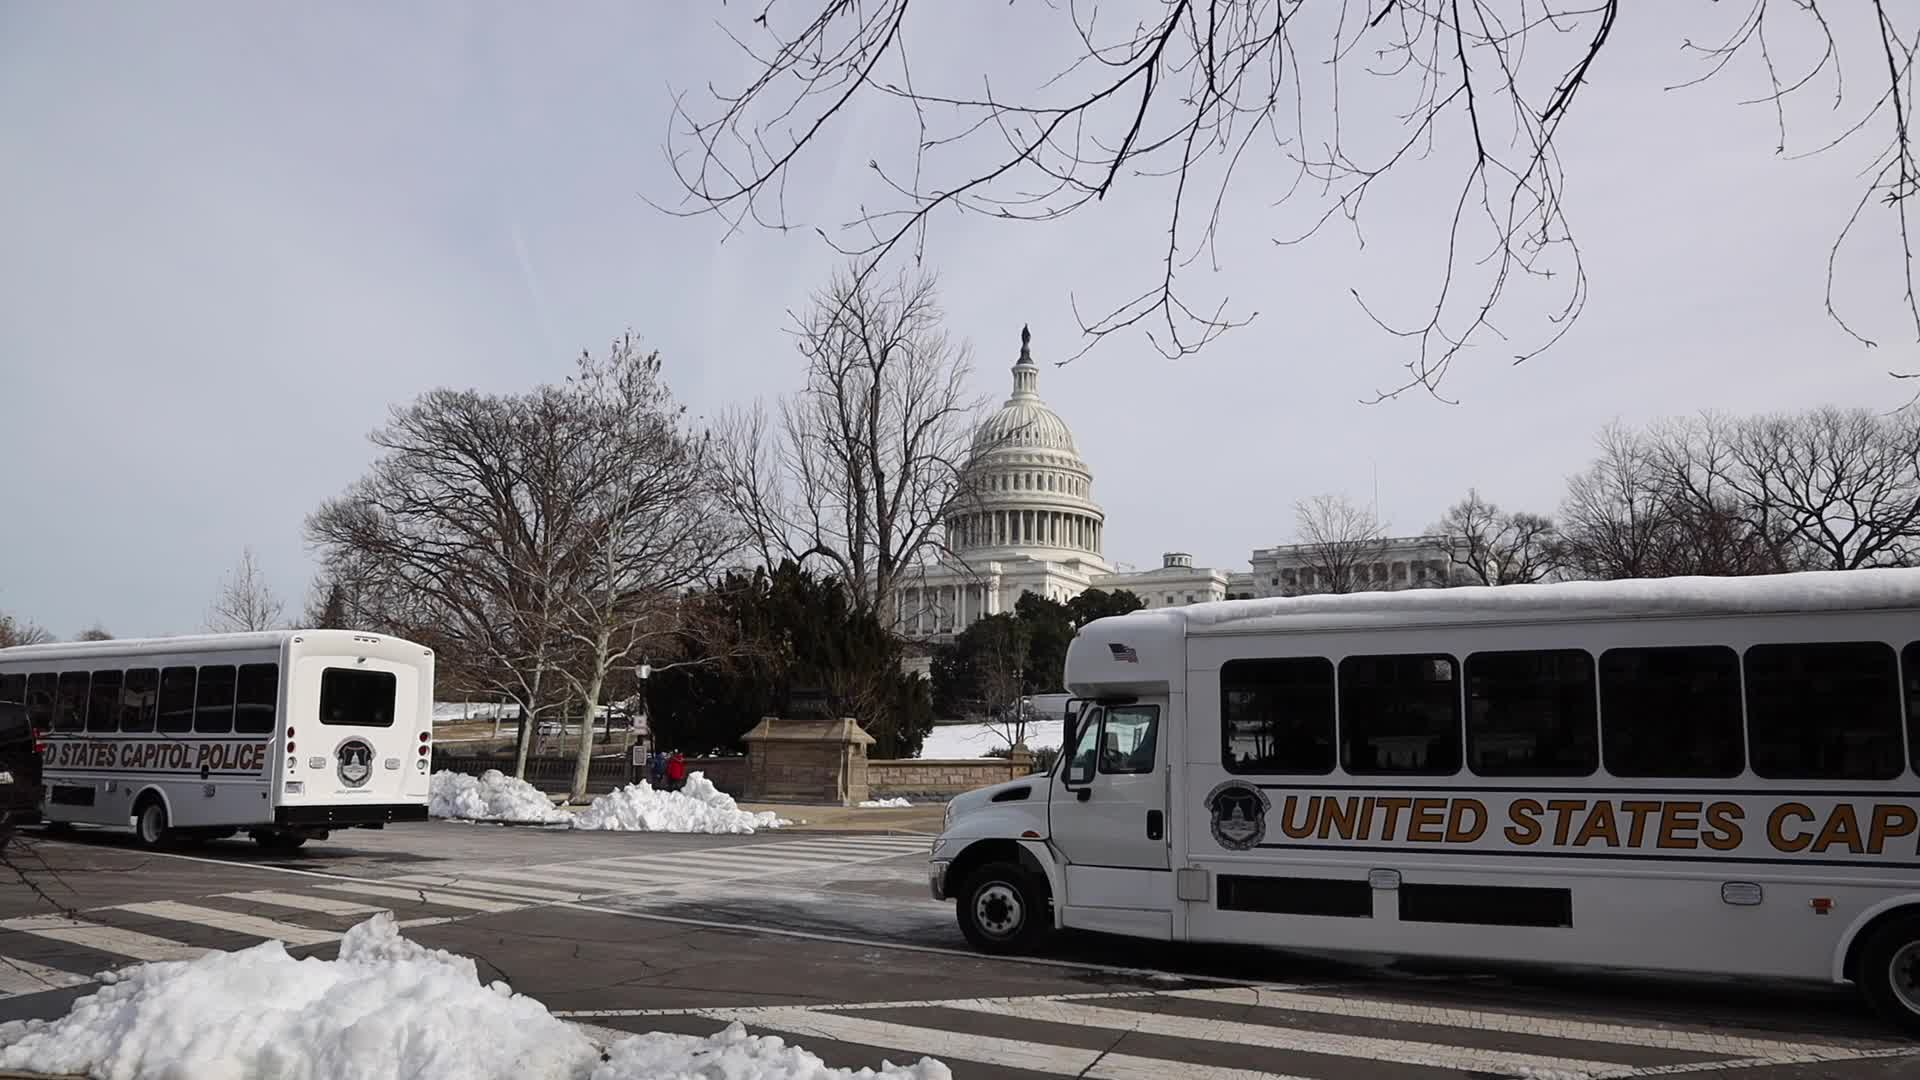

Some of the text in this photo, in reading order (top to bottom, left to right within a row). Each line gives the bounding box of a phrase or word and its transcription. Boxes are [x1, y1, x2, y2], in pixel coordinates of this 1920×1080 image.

[60, 743, 117, 768] STATES
[121, 744, 192, 769] CAPITOL
[197, 744, 266, 770] POLICE
[1281, 796, 1920, 856] UNITED STATES CAP
